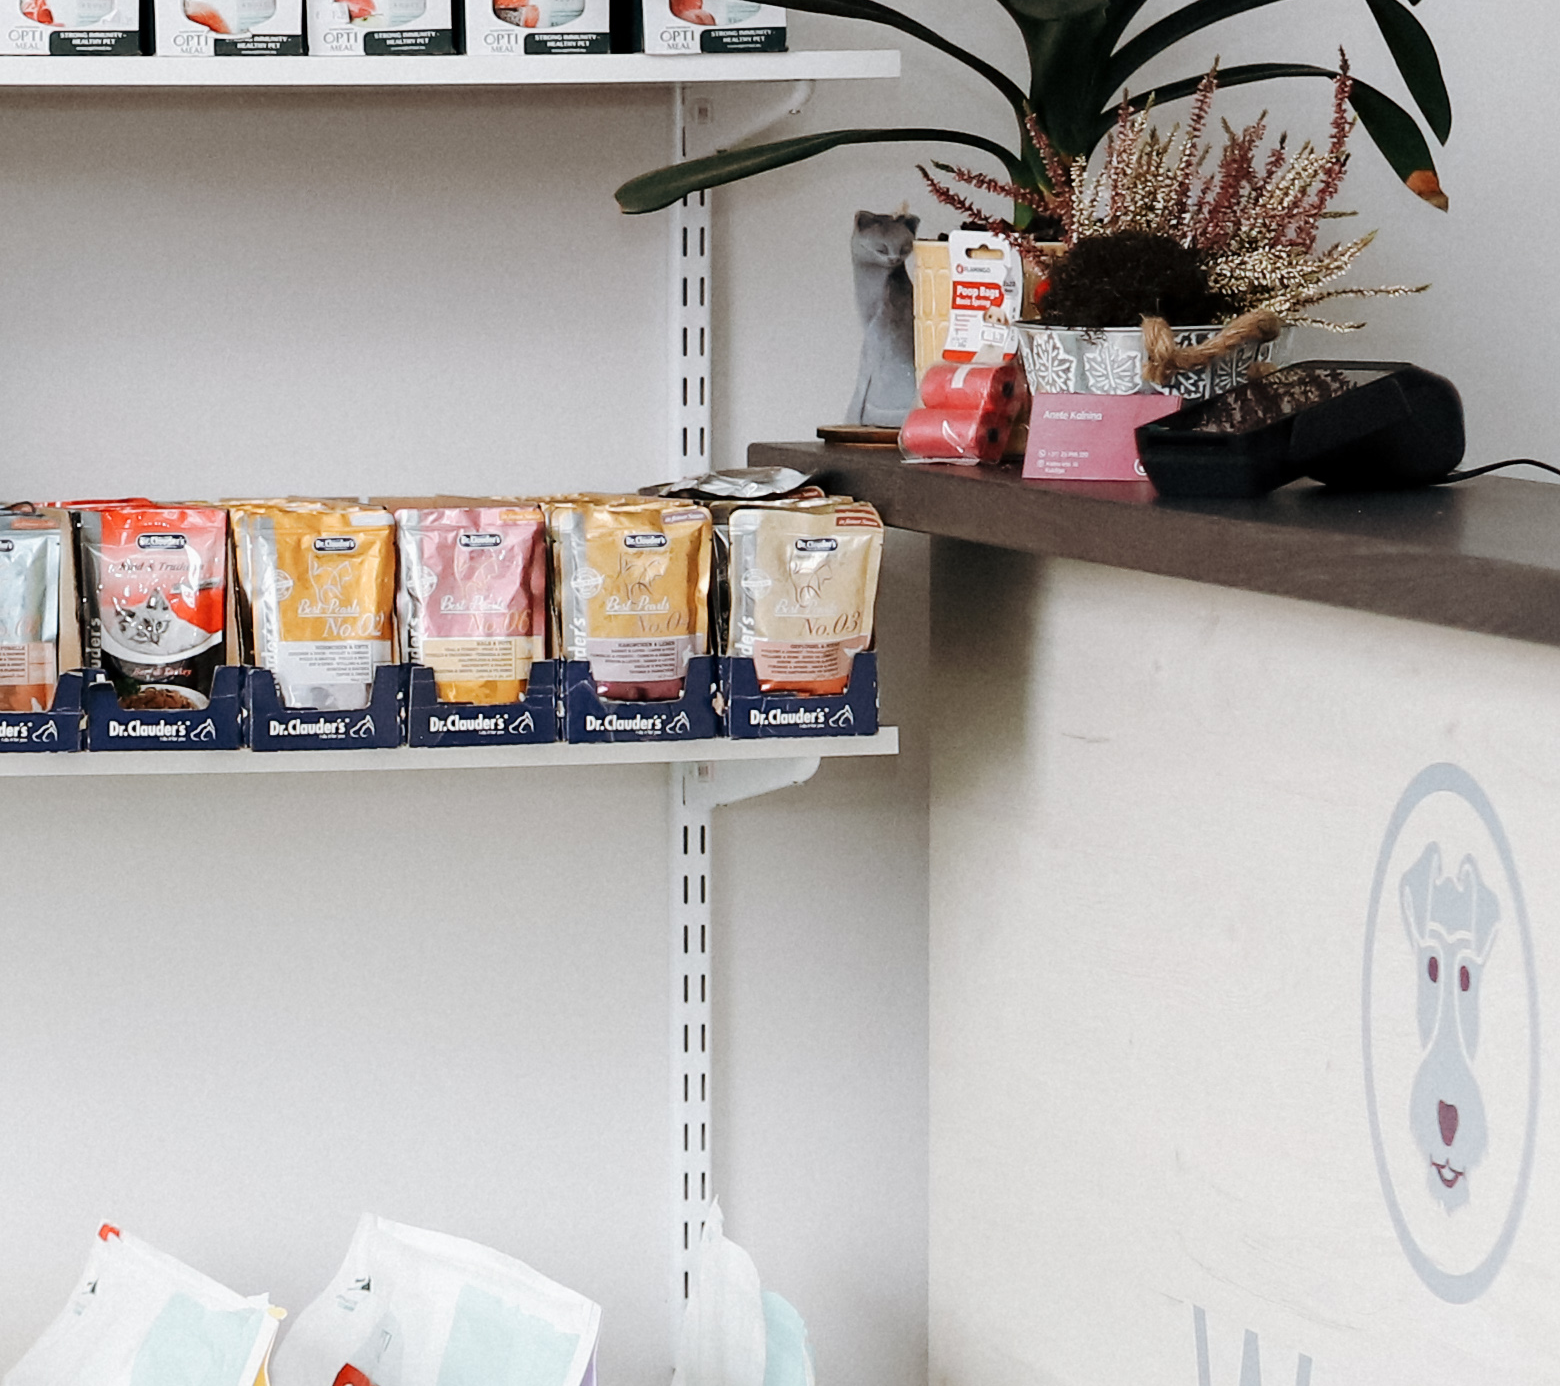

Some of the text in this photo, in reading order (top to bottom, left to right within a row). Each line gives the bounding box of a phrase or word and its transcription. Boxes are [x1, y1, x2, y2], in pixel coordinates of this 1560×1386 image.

[957, 286, 999, 298] Poop Bags
[429, 714, 504, 731] Dr.Clauder's
[586, 714, 661, 731] Dr.Clauder's
[750, 709, 825, 726] Dr.Clauder's
[108, 721, 186, 738] Dr.Clauder's
[270, 720, 346, 737] Dr.Clauder's
